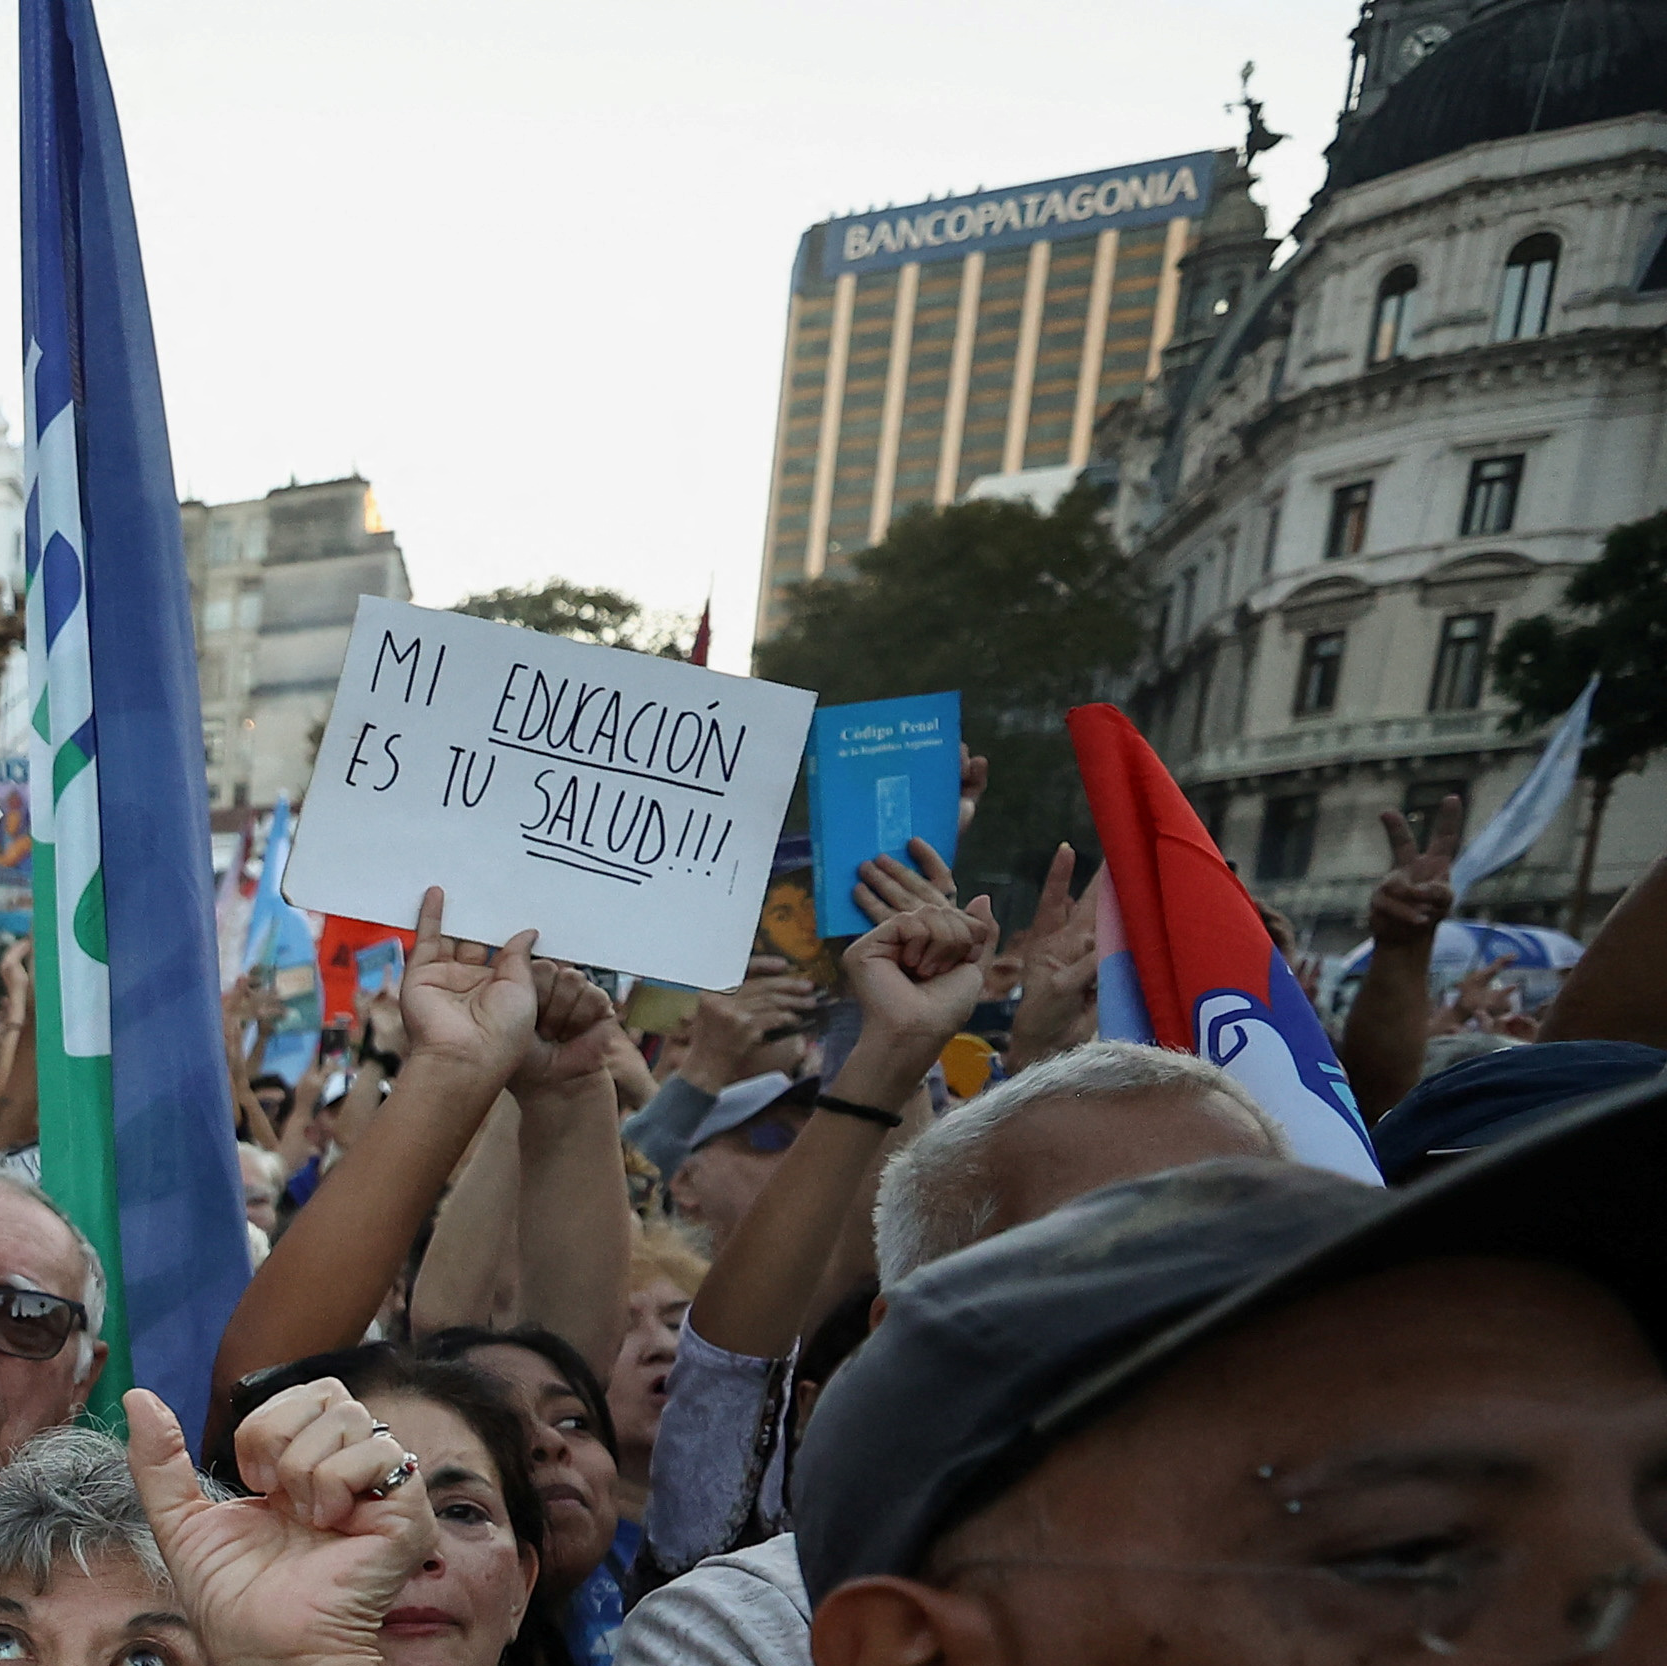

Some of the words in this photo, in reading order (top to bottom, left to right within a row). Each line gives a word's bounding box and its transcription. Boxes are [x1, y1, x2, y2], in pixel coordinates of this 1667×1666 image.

[371, 630, 445, 706] MI
[492, 663, 746, 783] EDUCACIÓN
[346, 722, 402, 791] ES
[442, 745, 496, 807] TU
[520, 769, 733, 877] SALUD!!!
